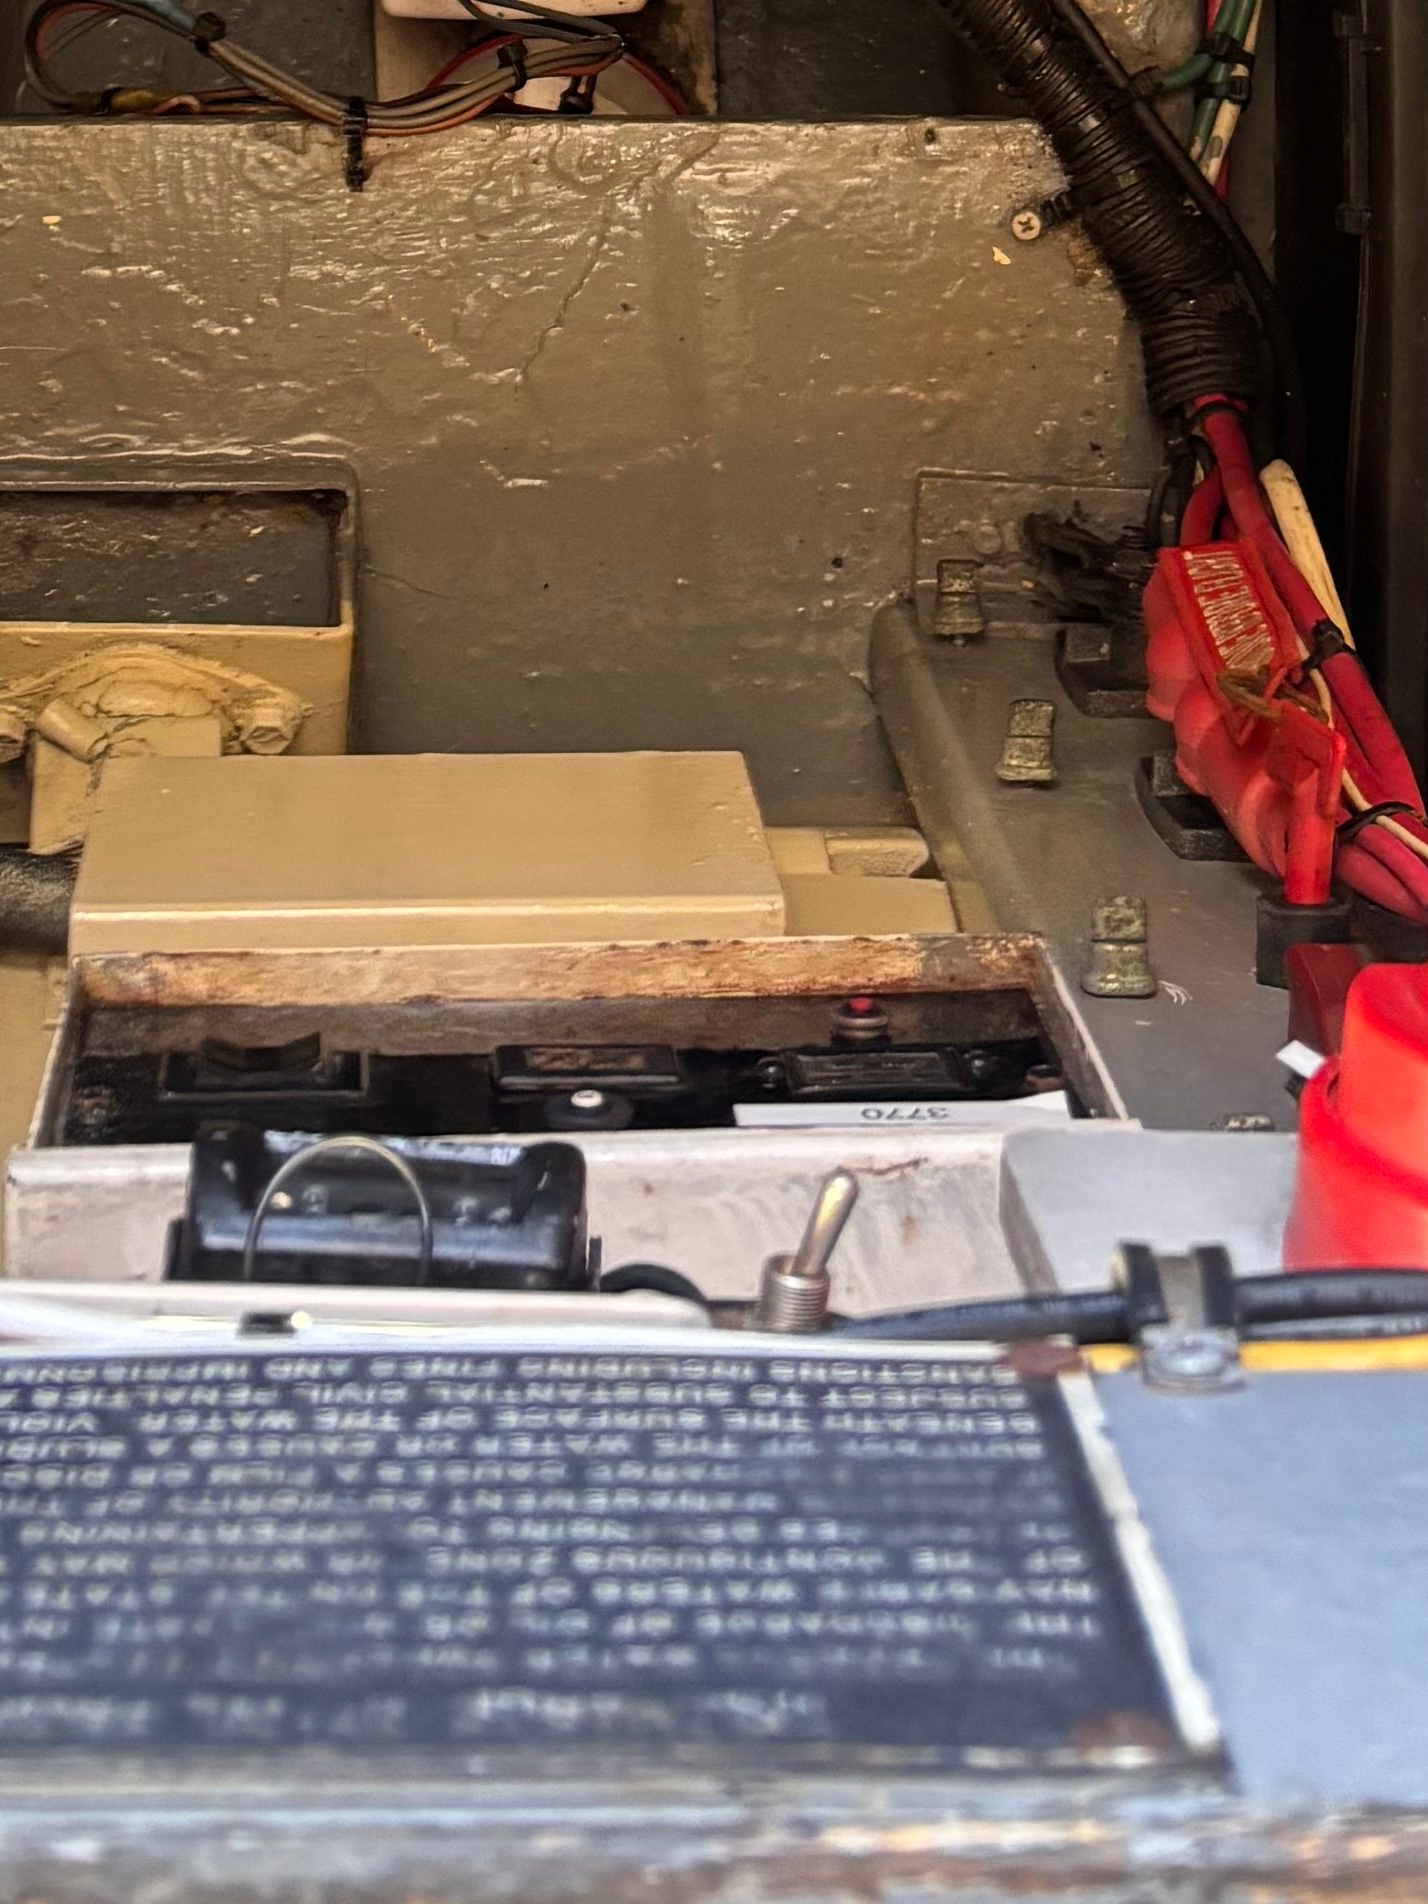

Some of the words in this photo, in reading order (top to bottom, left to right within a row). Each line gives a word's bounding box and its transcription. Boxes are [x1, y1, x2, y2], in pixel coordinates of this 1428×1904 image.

[860, 1106, 951, 1124] 3770
[266, 1358, 353, 1381] AND
[368, 1356, 499, 1380] FINES
[518, 1356, 754, 1381] INCLUDING
[769, 1361, 1011, 1384] SANCTIONS
[31, 1383, 279, 1407] PENALTIES
[292, 1381, 408, 1405] CIVIL
[426, 1381, 730, 1406] SUBSTANTIAL
[749, 1384, 804, 1408] TO
[822, 1386, 1028, 1409] SUBJECT
[314, 1408, 401, 1431] THE
[416, 1408, 477, 1430] OF
[494, 1407, 704, 1430] SURFACE
[723, 1409, 810, 1432] THE
[822, 1411, 1038, 1433] BENEATH
[145, 1435, 173, 1457] A
[191, 1433, 378, 1457] CAUSES
[474, 1432, 631, 1455] WATER
[653, 1433, 737, 1457] THE
[446, 1488, 780, 1511] MANAGEMENT
[33, 1554, 131, 1578] MAY
[590, 1578, 797, 1600] WATERS
